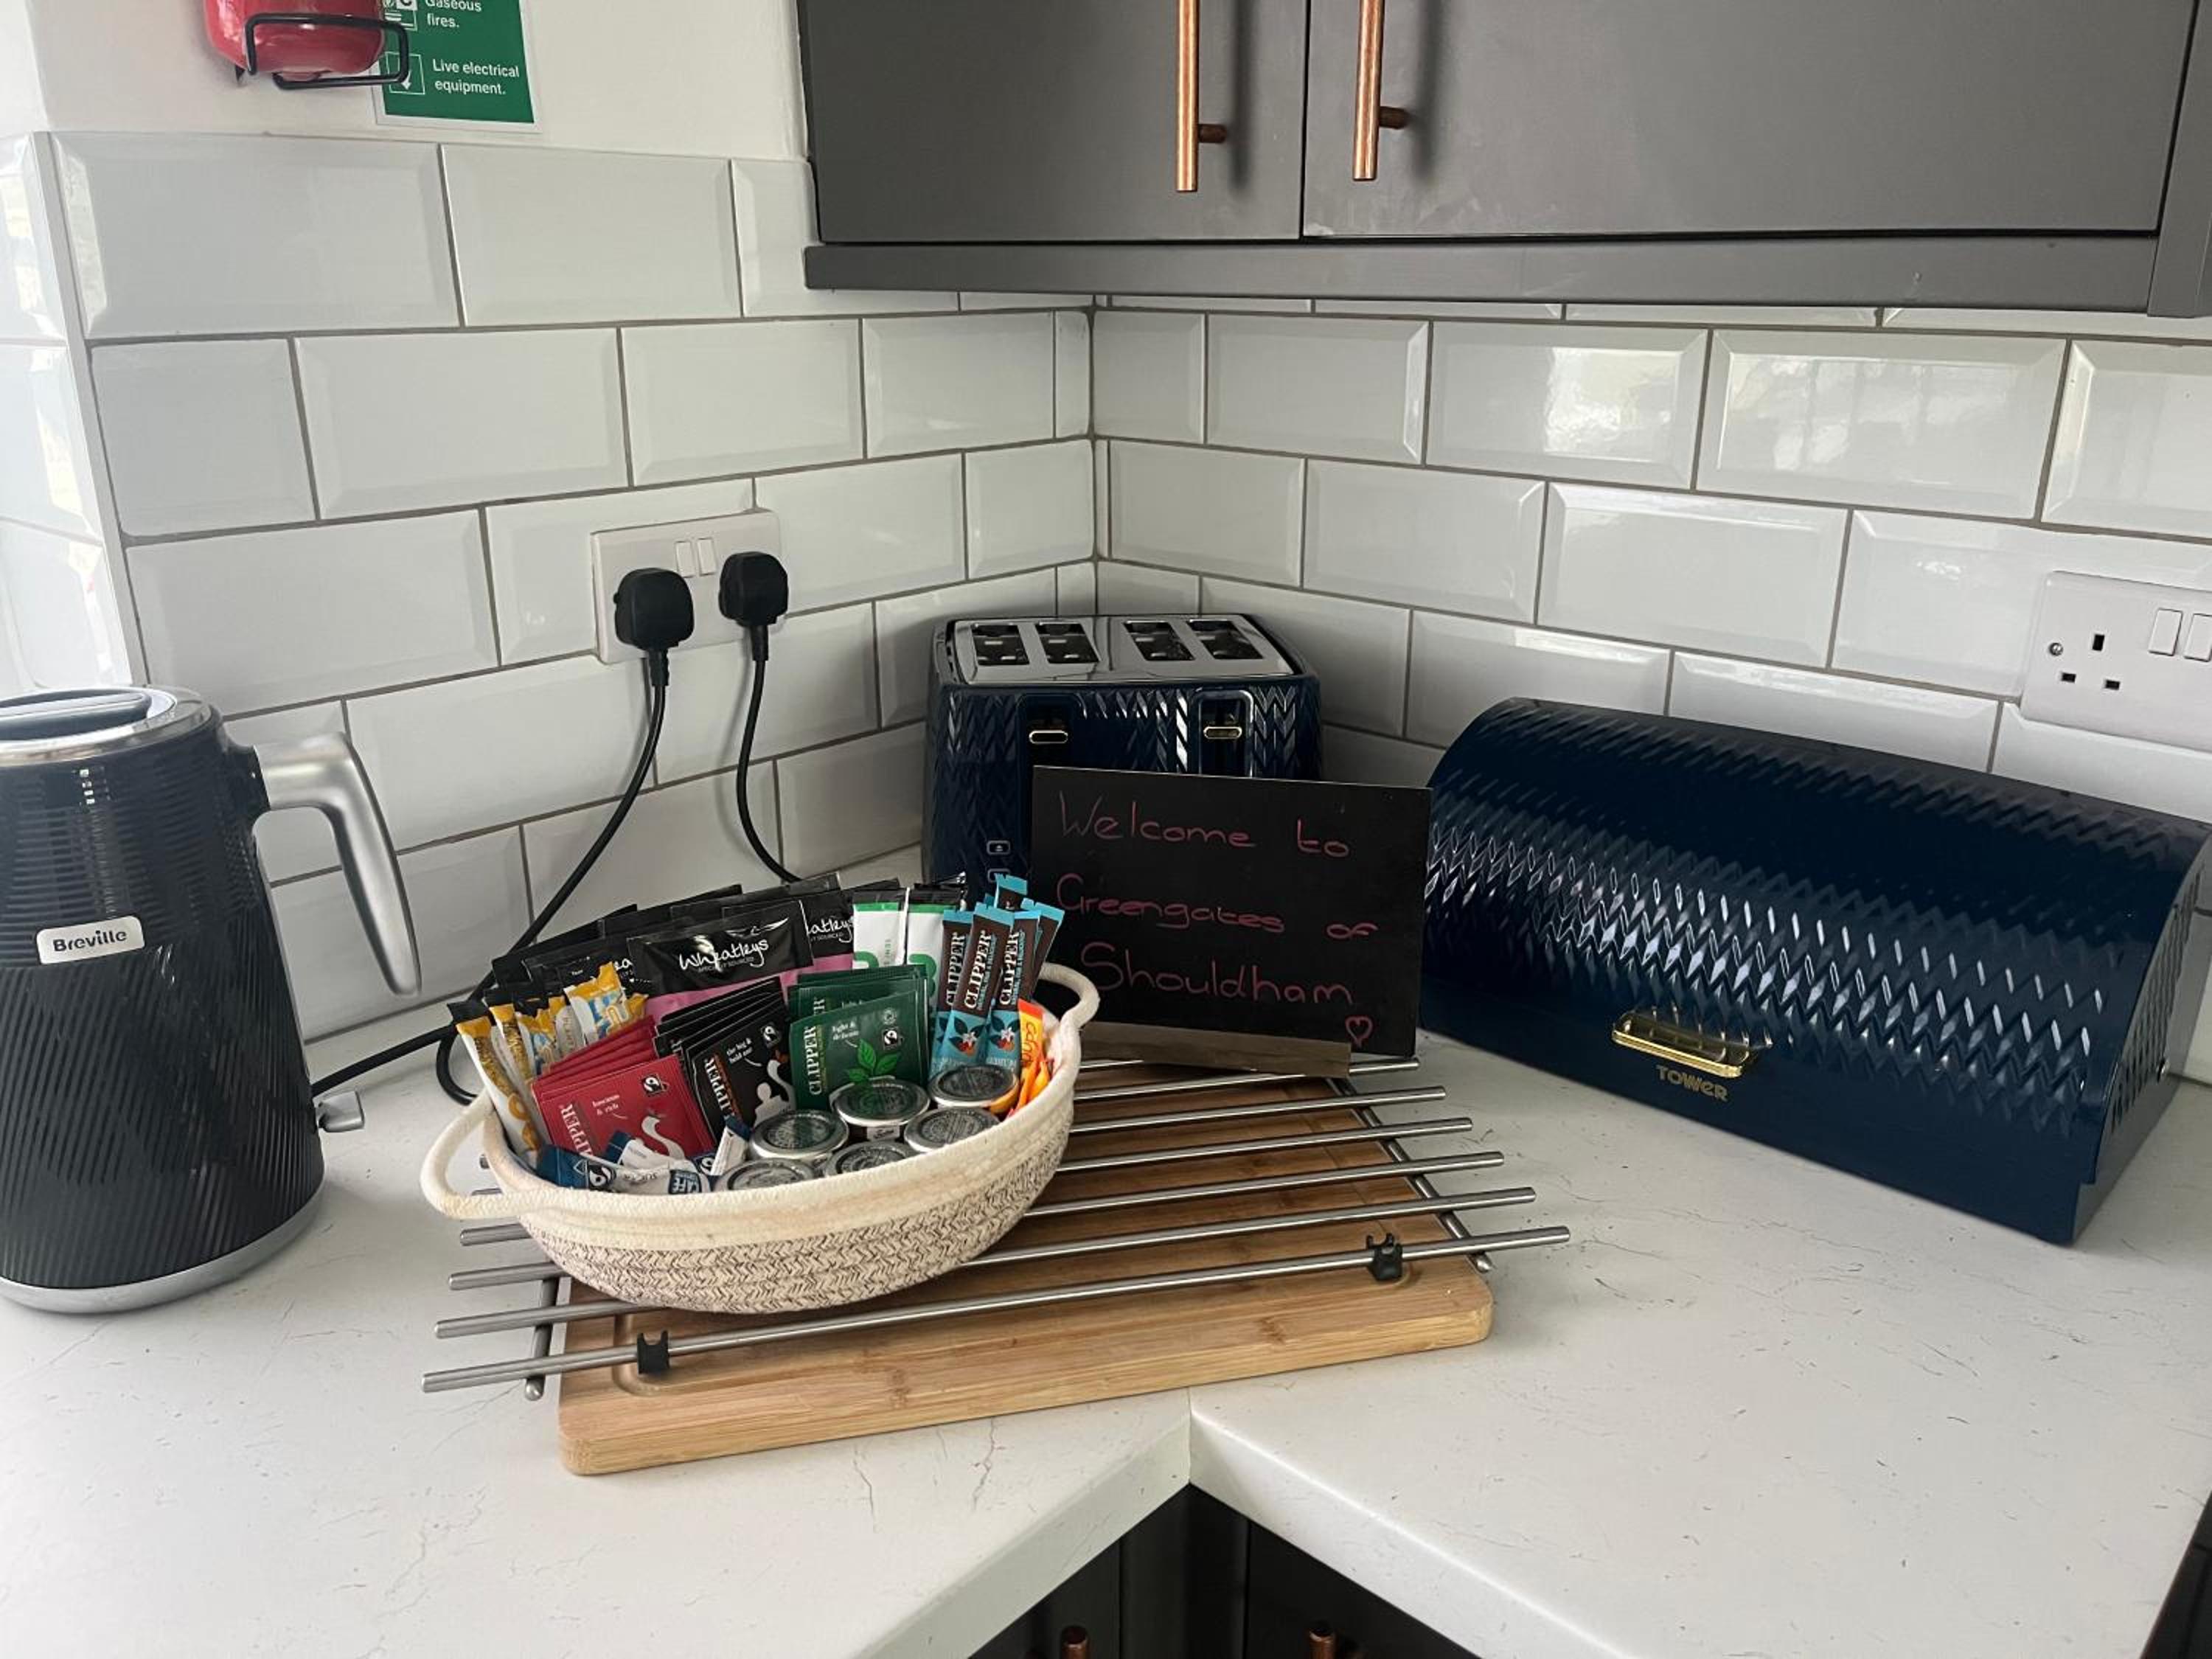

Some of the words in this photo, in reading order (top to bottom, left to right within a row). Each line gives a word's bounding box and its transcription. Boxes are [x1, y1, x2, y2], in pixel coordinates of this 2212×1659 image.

[427, 13, 459, 27] fires.
[433, 59, 459, 72] Live
[463, 63, 519, 77] electrical
[435, 80, 506, 94] equipment.
[1060, 790, 1256, 847] Welcome
[1297, 819, 1349, 857] to
[1057, 874, 1284, 933] Greengates
[53, 931, 127, 951] Breville
[964, 930, 992, 1009] CLIPPER
[999, 931, 1020, 1005] CLIPPER
[1081, 942, 1353, 1004] Shouldham
[704, 1057, 736, 1119] LIPPER
[804, 1026, 822, 1095] CLIPPER
[1657, 1065, 1729, 1102] TOWER
